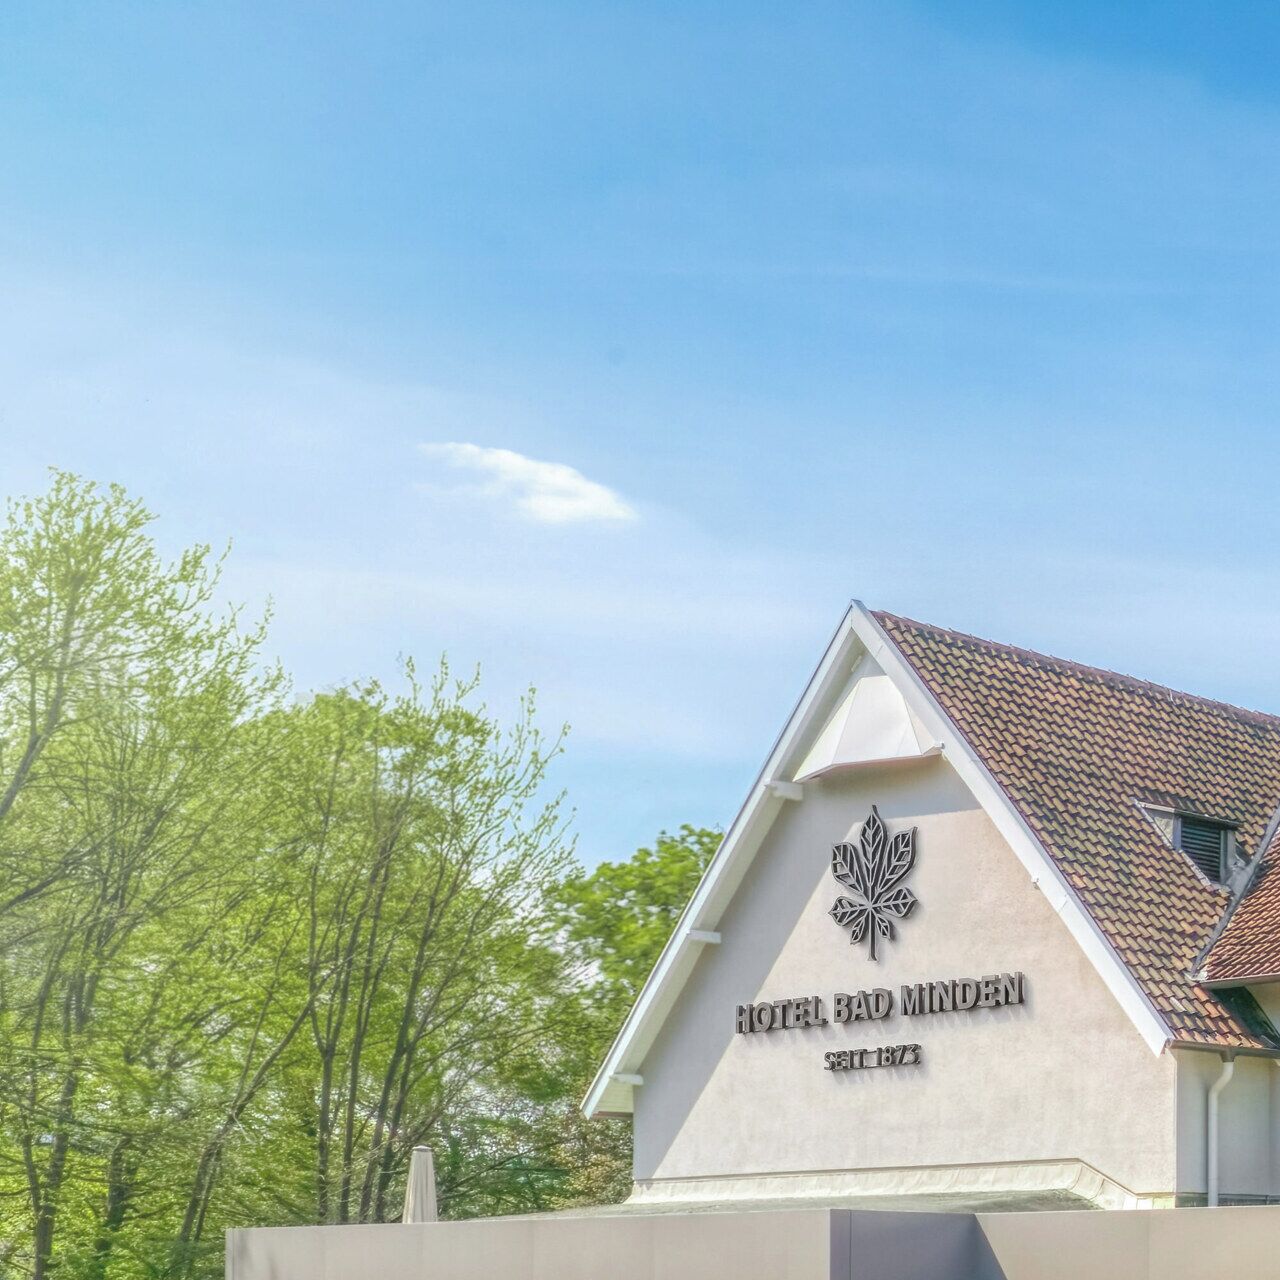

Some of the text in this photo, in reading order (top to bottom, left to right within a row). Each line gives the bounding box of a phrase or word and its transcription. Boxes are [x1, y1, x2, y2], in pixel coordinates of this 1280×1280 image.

[736, 971, 1026, 1034] HOTEL BAD MINDEN
[824, 1043, 922, 1071] SEIT 1873
